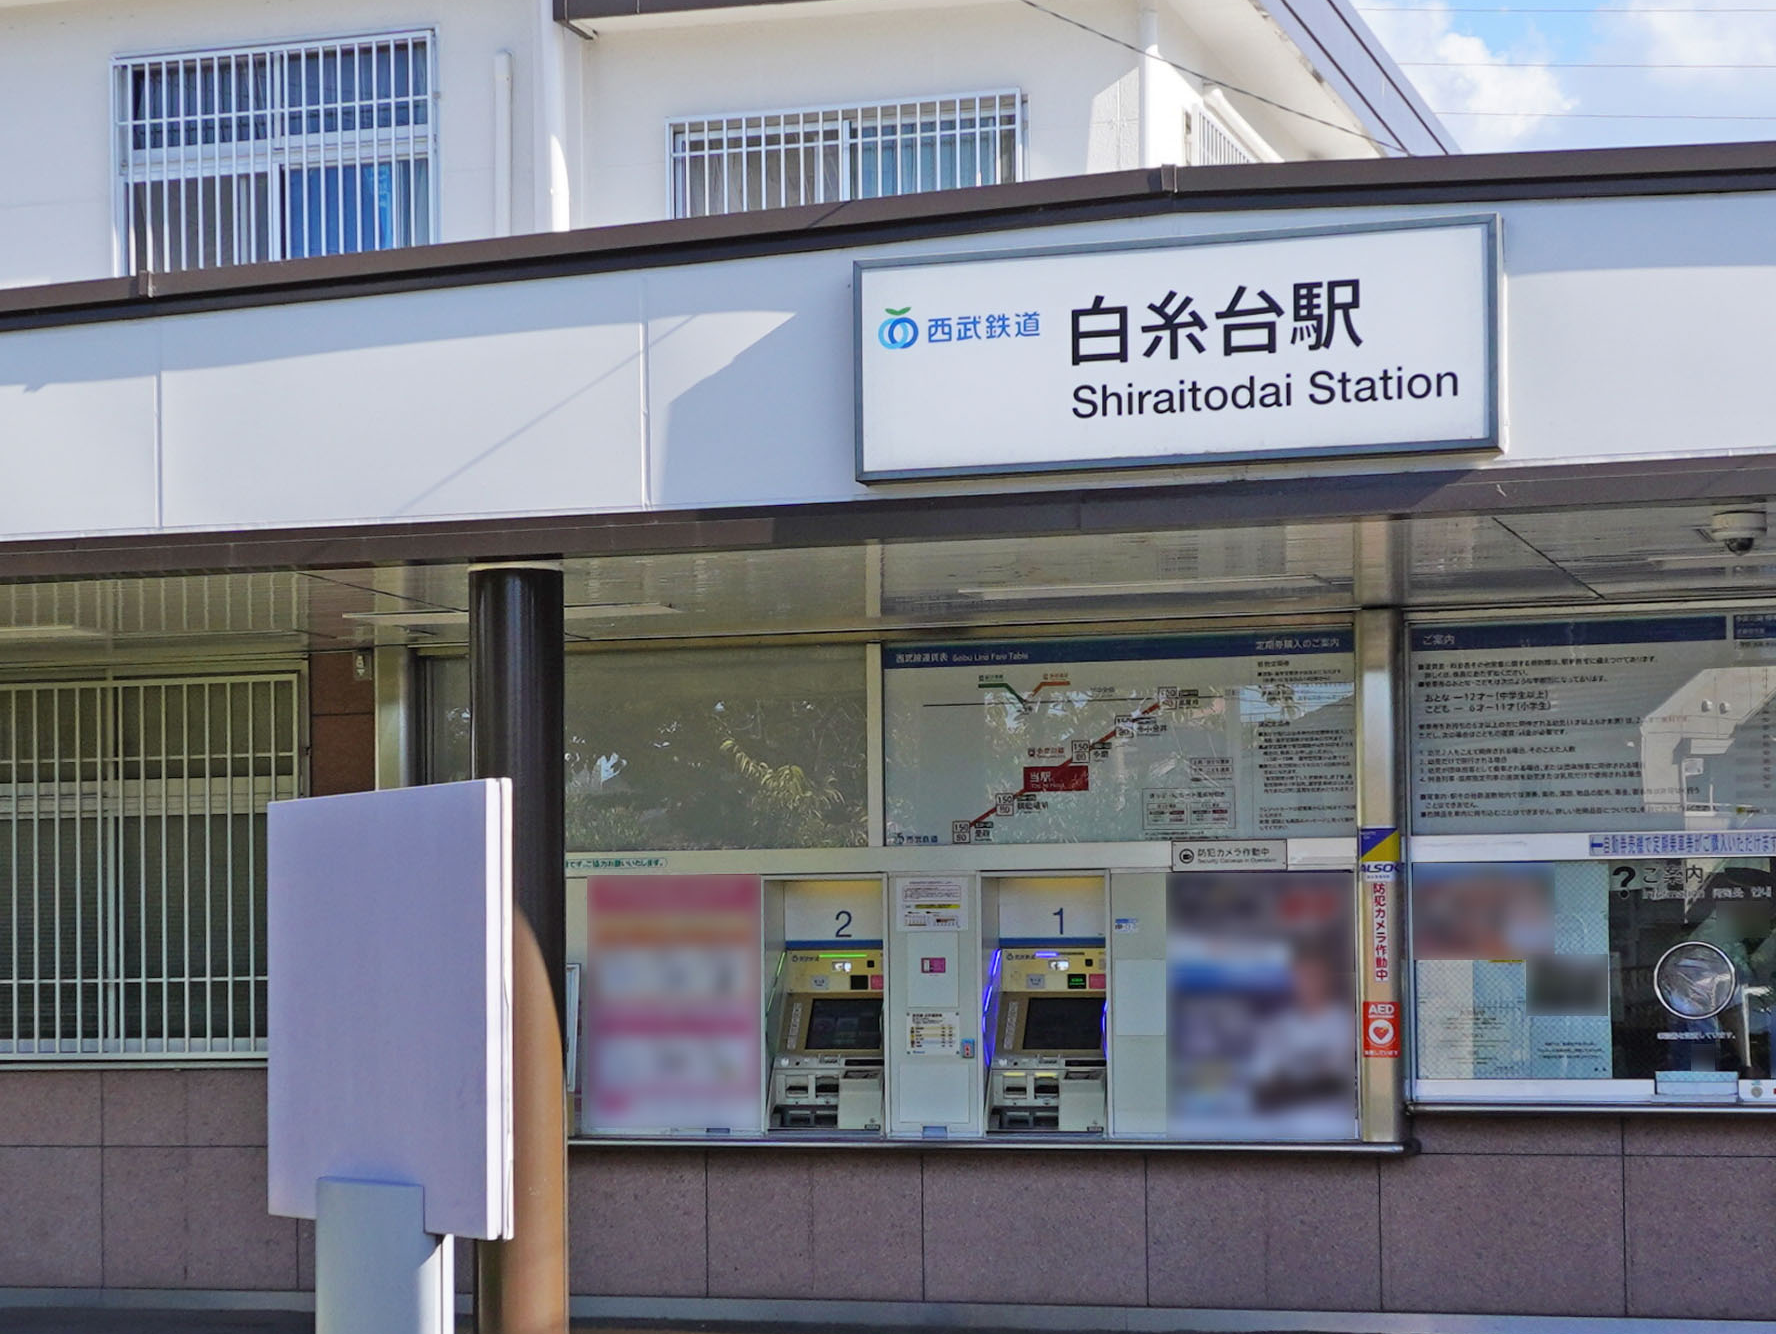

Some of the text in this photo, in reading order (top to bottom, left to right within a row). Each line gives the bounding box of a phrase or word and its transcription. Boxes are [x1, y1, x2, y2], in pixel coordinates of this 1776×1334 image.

[927, 310, 1040, 344] 西武鉄道
[1070, 278, 1363, 366] 白糸台駅
[1072, 365, 1459, 419] Shiraitodai Station
[1198, 847, 1270, 858] 防犯カメラ作動中
[1643, 865, 1703, 885] ご案内
[835, 910, 852, 938] 2
[1052, 907, 1064, 935] 1
[1373, 883, 1388, 981] 防犯カメラ作動中
[1368, 1004, 1395, 1015] AED
